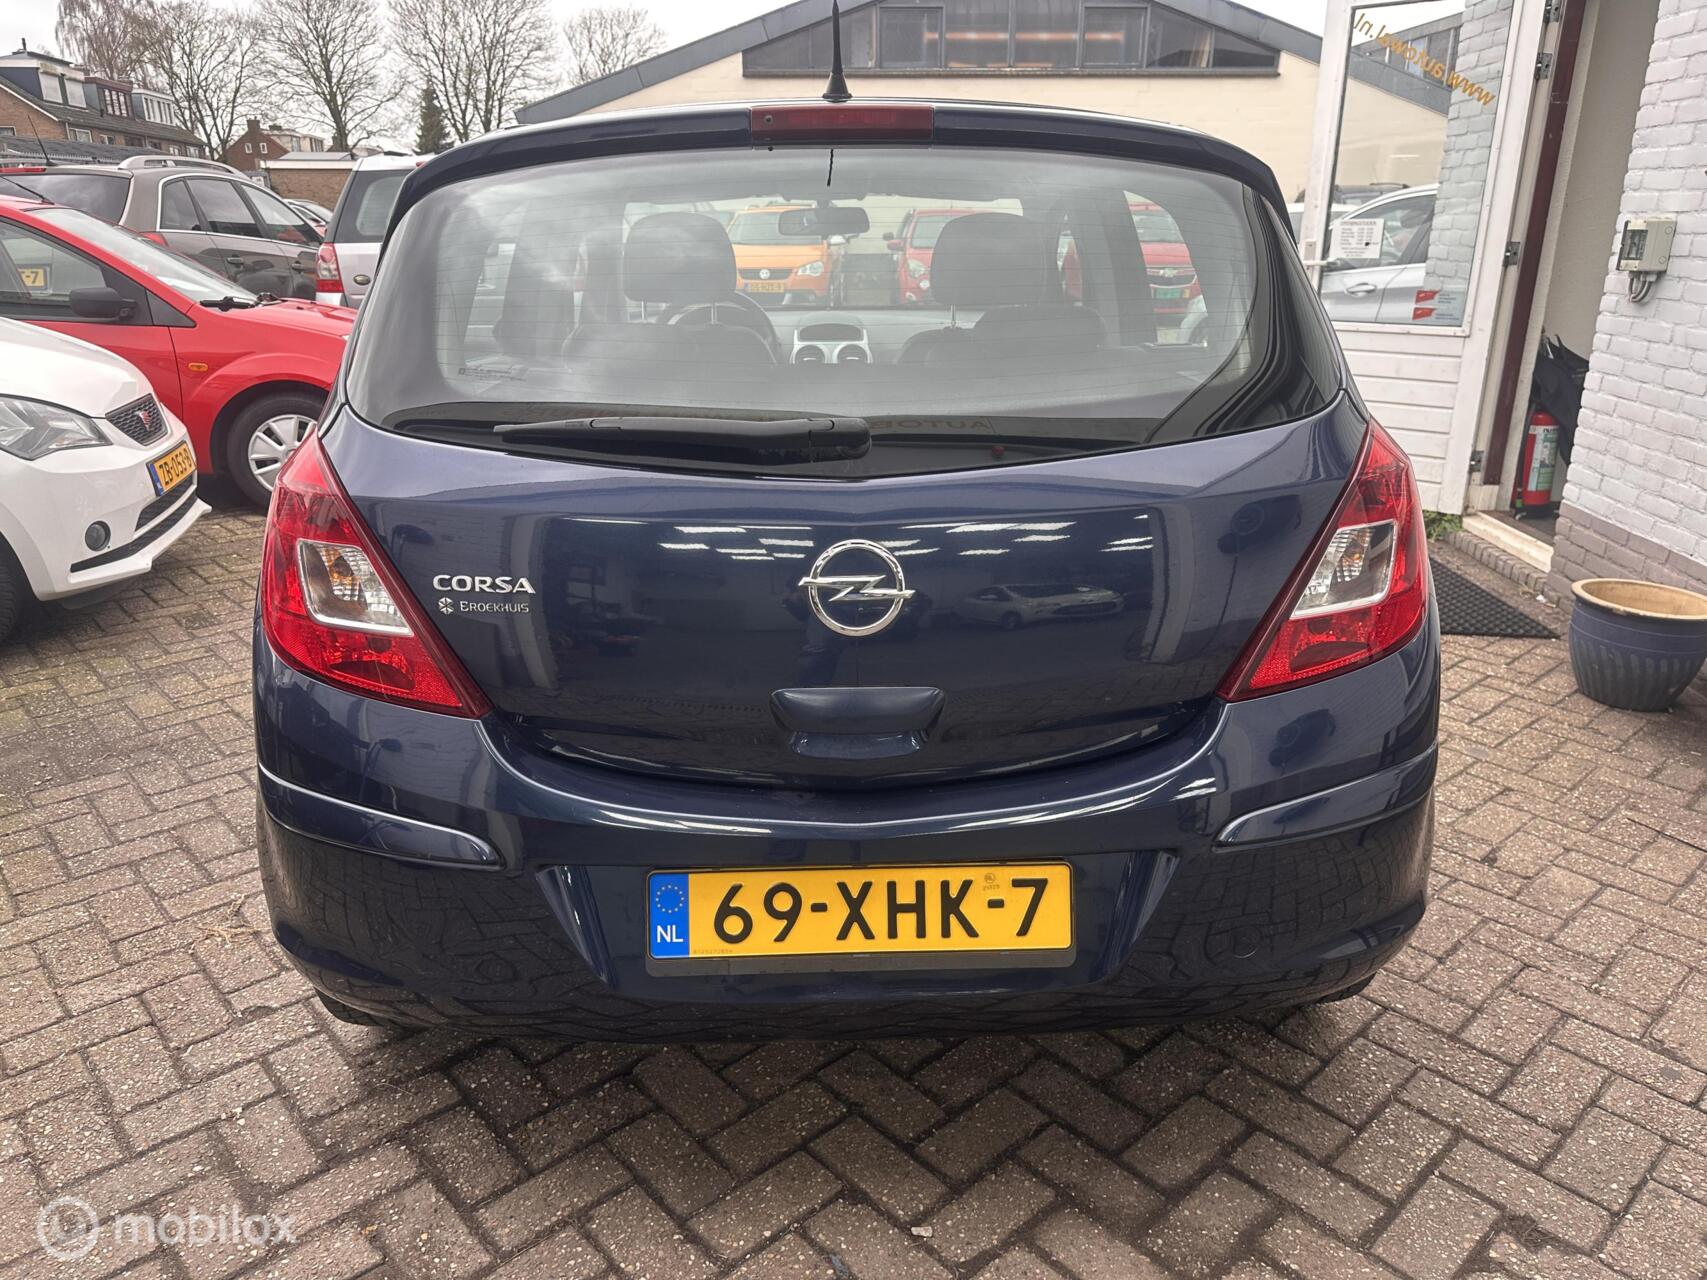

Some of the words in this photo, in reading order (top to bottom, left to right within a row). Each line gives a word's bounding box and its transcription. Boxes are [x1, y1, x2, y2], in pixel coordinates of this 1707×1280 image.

[432, 574, 536, 594] CORSA
[713, 877, 1050, 945] 69-XHK-7
[656, 924, 684, 944] NL
